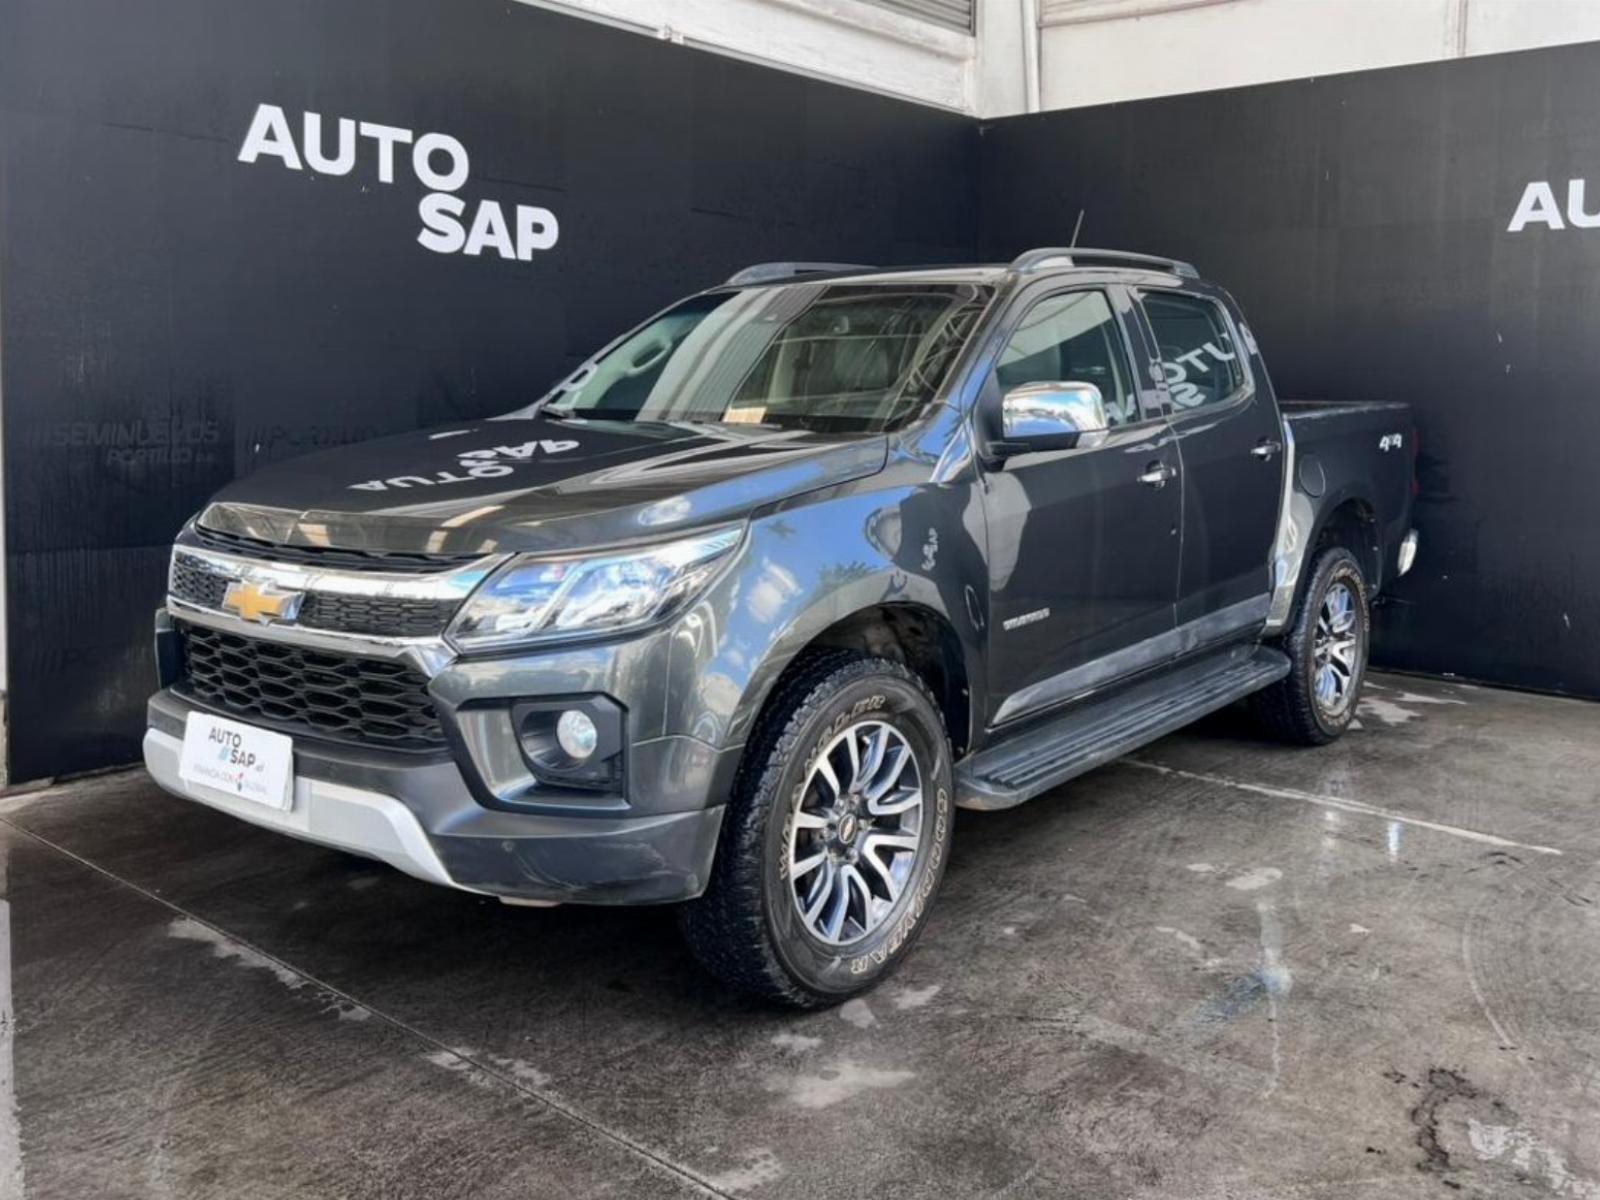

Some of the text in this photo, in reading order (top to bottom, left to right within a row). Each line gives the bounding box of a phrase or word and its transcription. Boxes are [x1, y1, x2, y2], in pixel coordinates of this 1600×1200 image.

[238, 103, 470, 192] AUTO
[417, 193, 559, 261] SAP
[1507, 179, 1600, 232] AU
[208, 725, 242, 748] AUTO
[851, 787, 949, 975] GOODYEAR
